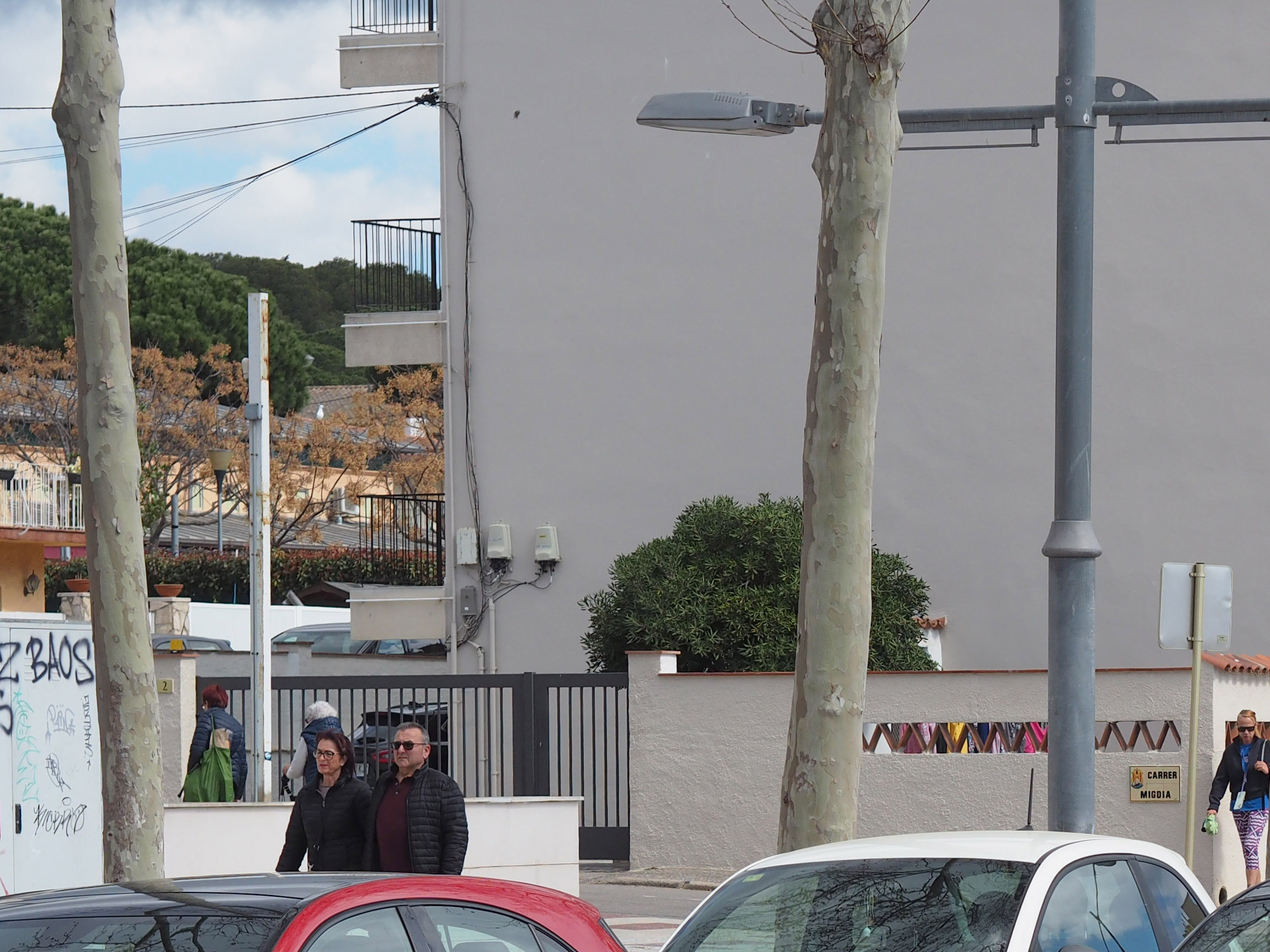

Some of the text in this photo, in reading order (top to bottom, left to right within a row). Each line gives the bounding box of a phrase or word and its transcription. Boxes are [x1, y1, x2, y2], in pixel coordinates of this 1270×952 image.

[162, 680, 168, 691] 2
[1148, 771, 1177, 779] CARRER
[1140, 791, 1171, 799] MIGDIA
